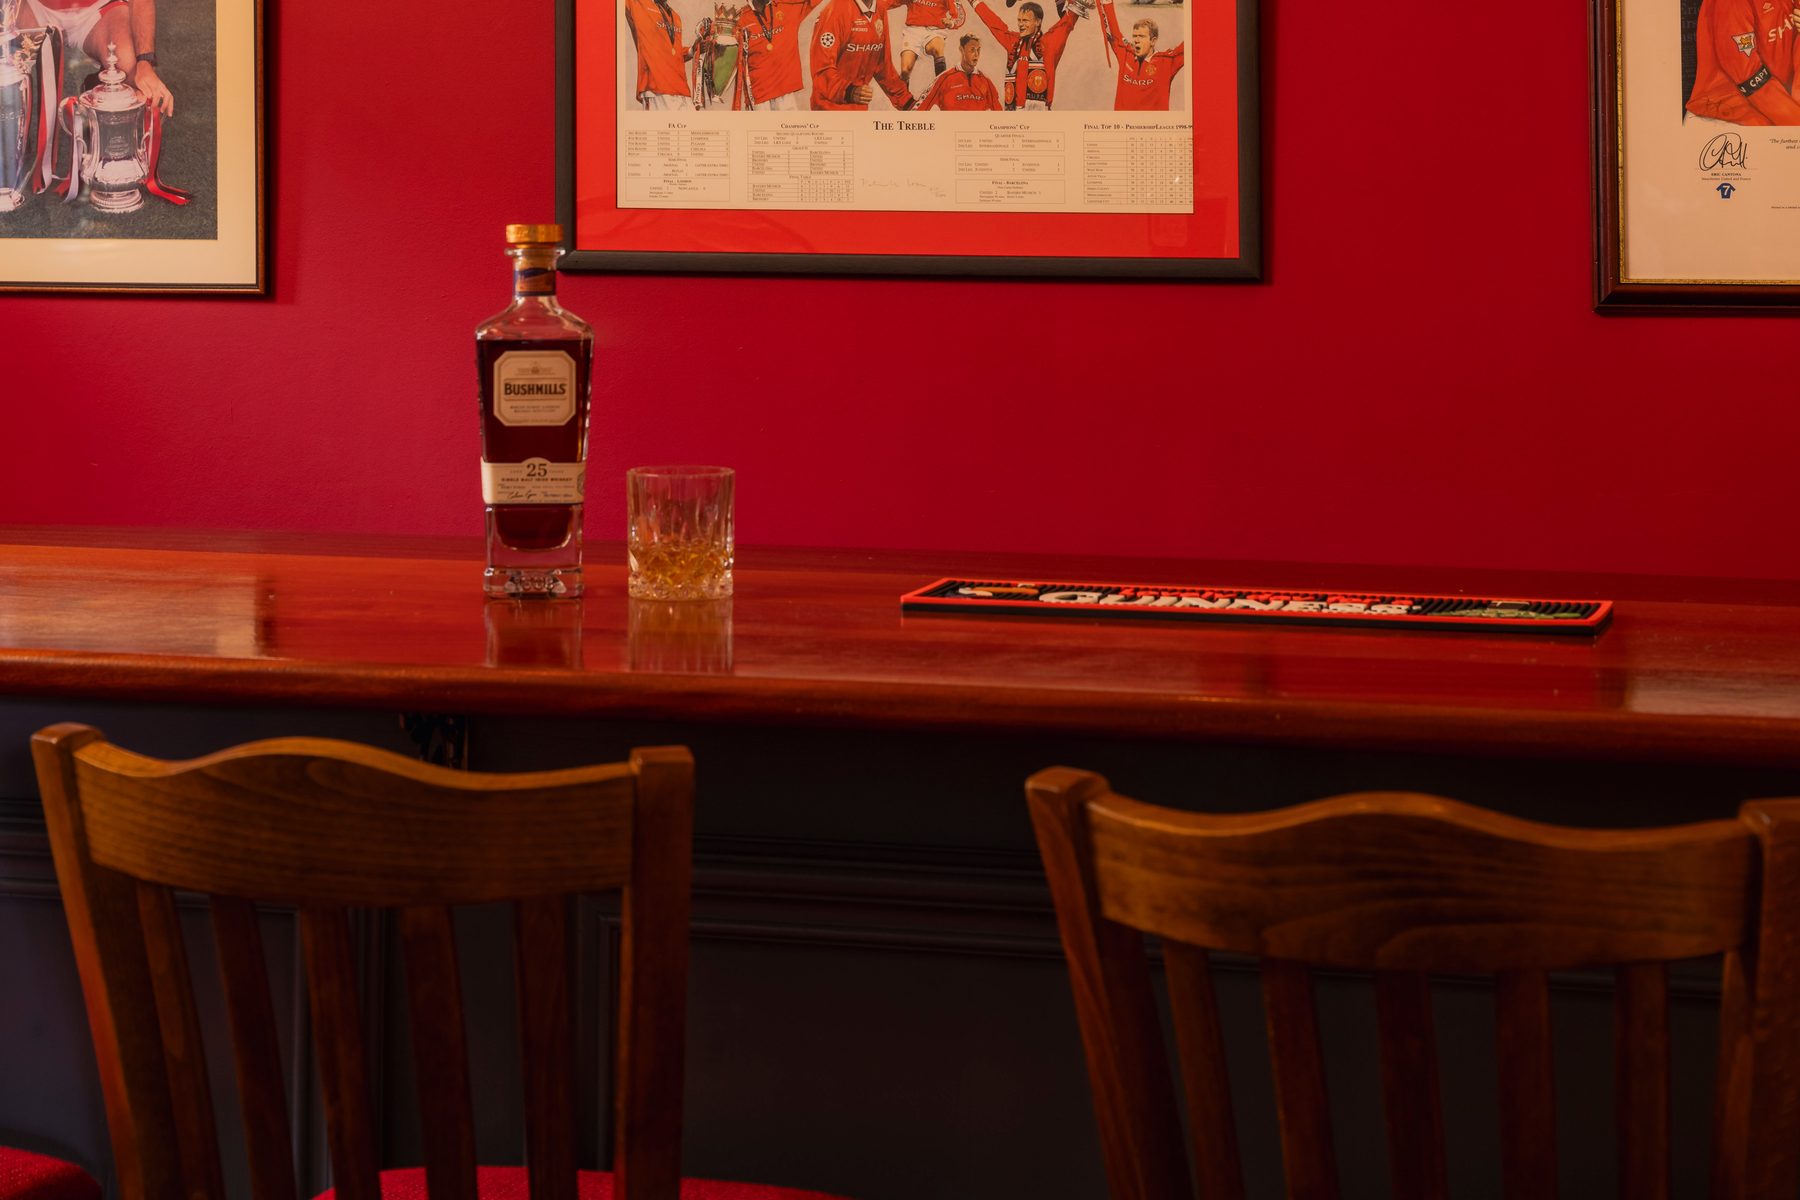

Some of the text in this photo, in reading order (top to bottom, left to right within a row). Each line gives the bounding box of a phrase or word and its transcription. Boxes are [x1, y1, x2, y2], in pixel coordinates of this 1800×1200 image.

[846, 42, 884, 53] SHARP
[1122, 74, 1154, 86] SHARP
[873, 120, 936, 131] THE TREBLE
[1722, 185, 1731, 197] 7
[504, 382, 567, 396] BUSHMILLS
[526, 463, 548, 477] 25
